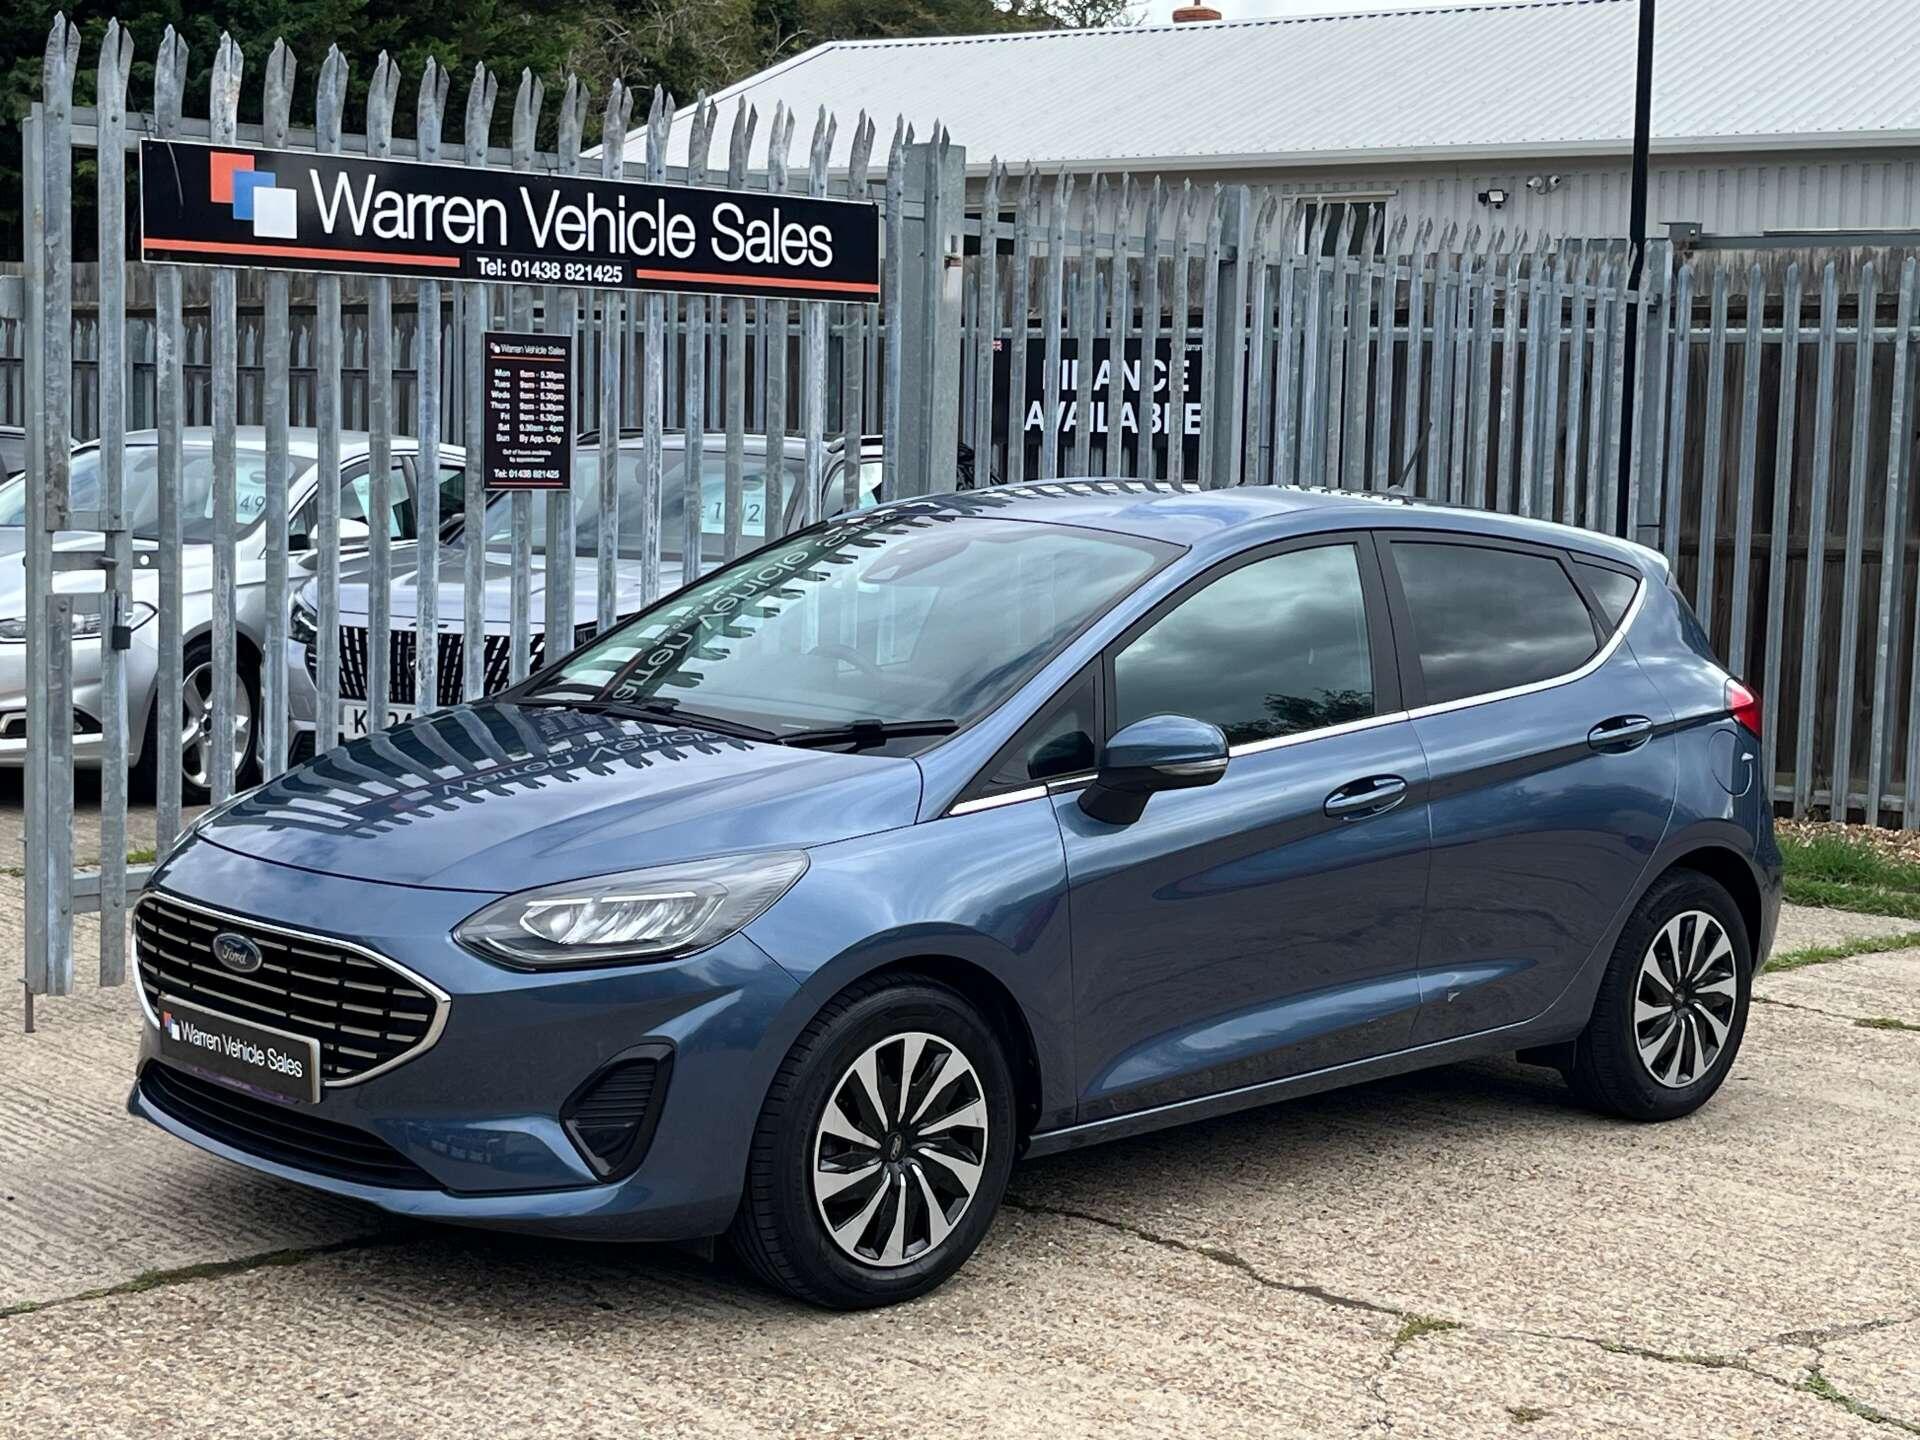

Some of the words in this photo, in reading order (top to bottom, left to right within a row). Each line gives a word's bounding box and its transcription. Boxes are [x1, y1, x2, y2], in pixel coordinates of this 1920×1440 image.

[309, 168, 508, 247] Warren
[519, 186, 696, 259] Vehicle
[710, 202, 833, 268] Sales
[476, 256, 507, 277] Tel:
[510, 259, 561, 280] 01438
[564, 262, 623, 284] 821425
[500, 343, 524, 354] Warren
[525, 345, 547, 355] Vehicle
[494, 368, 511, 377] Mon
[493, 379, 511, 388] Tues
[490, 390, 511, 399] Weds
[490, 401, 511, 410] Thurs
[500, 412, 510, 420] Fri
[497, 423, 510, 431] Sat
[496, 433, 510, 442] Sun
[519, 434, 529, 444] By
[545, 435, 562, 445] Only
[222, 940, 248, 965] Ford
[180, 1019, 222, 1053] Warren
[221, 1033, 265, 1067] Vehicle
[267, 1047, 303, 1078] Sales
